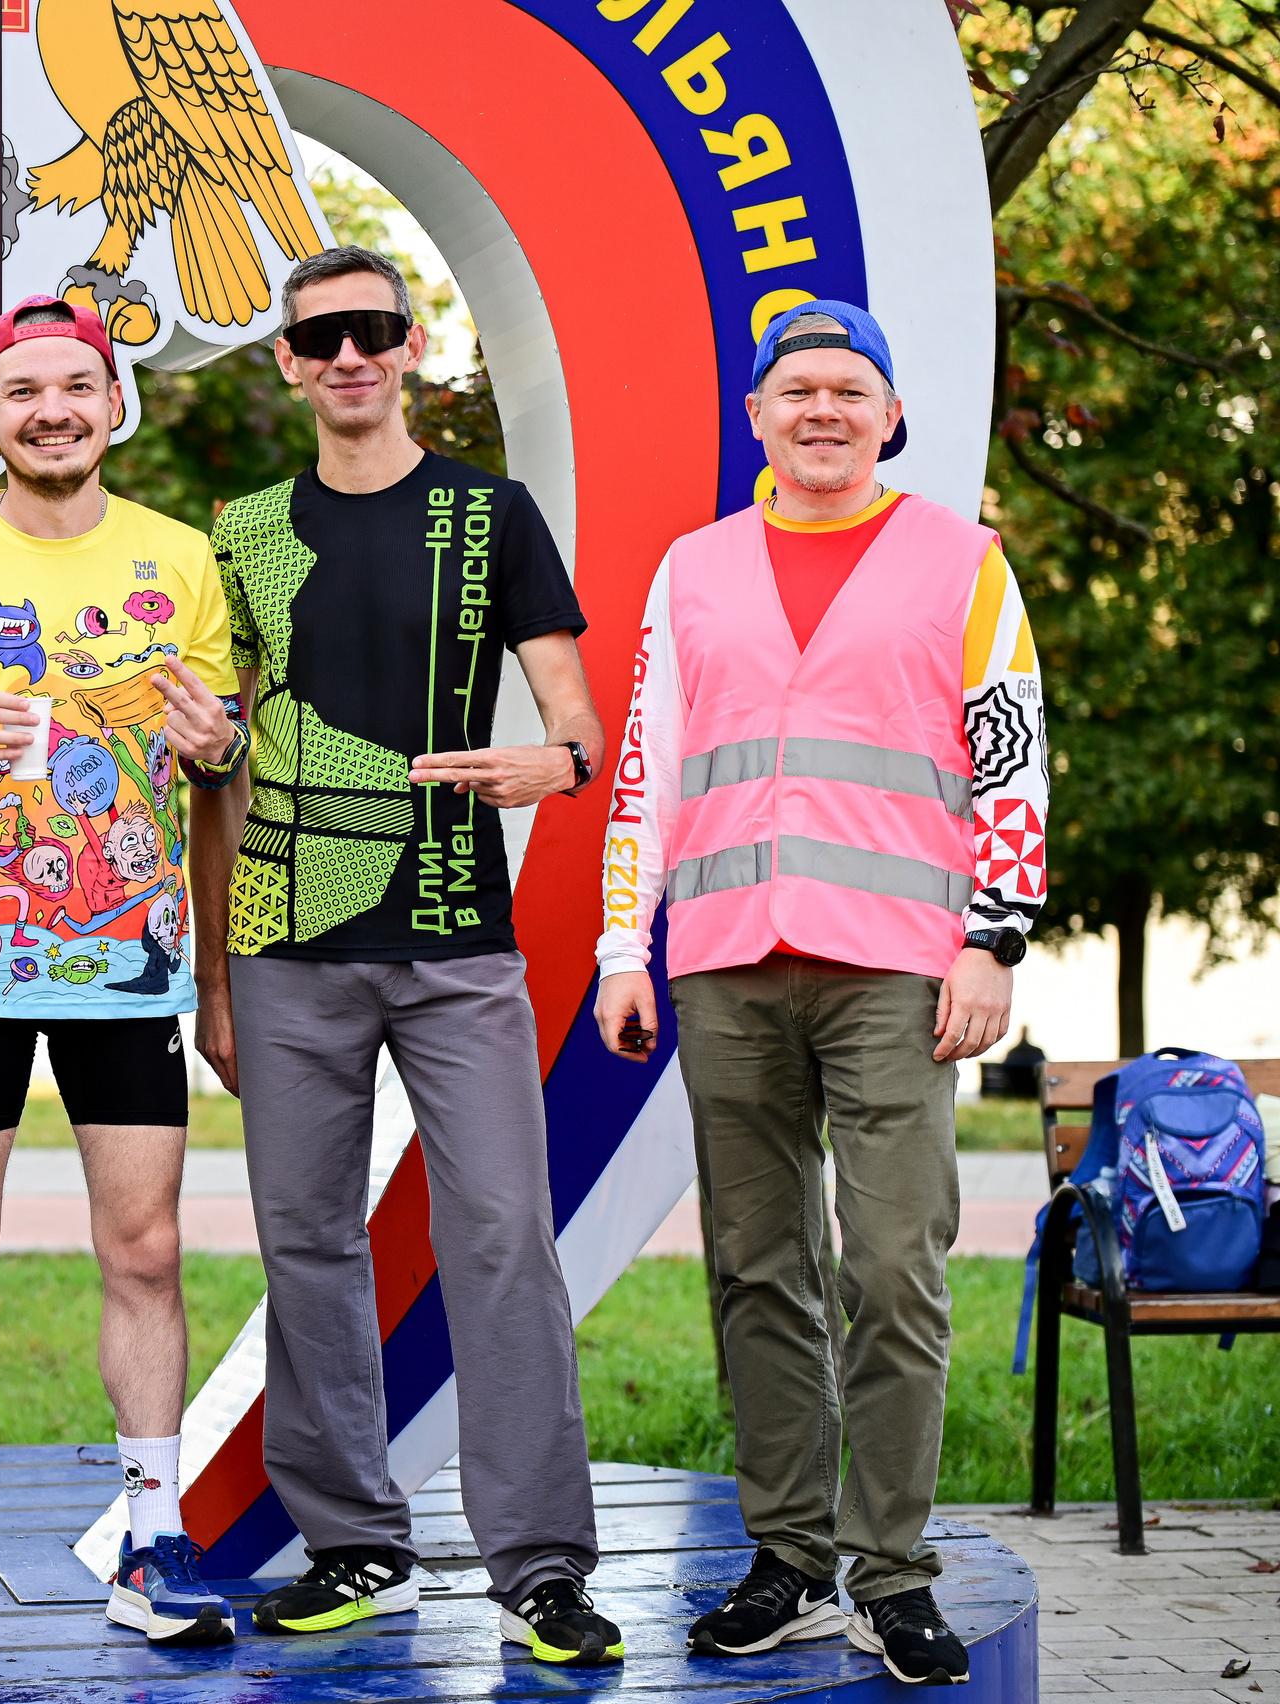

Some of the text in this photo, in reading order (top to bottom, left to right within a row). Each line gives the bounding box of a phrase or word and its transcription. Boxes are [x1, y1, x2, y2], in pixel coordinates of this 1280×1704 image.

[132, 559, 157, 571] THAI
[135, 569, 158, 580] RUN
[65, 754, 103, 788] thai
[607, 836, 639, 931] 2023
[454, 907, 482, 927] в
